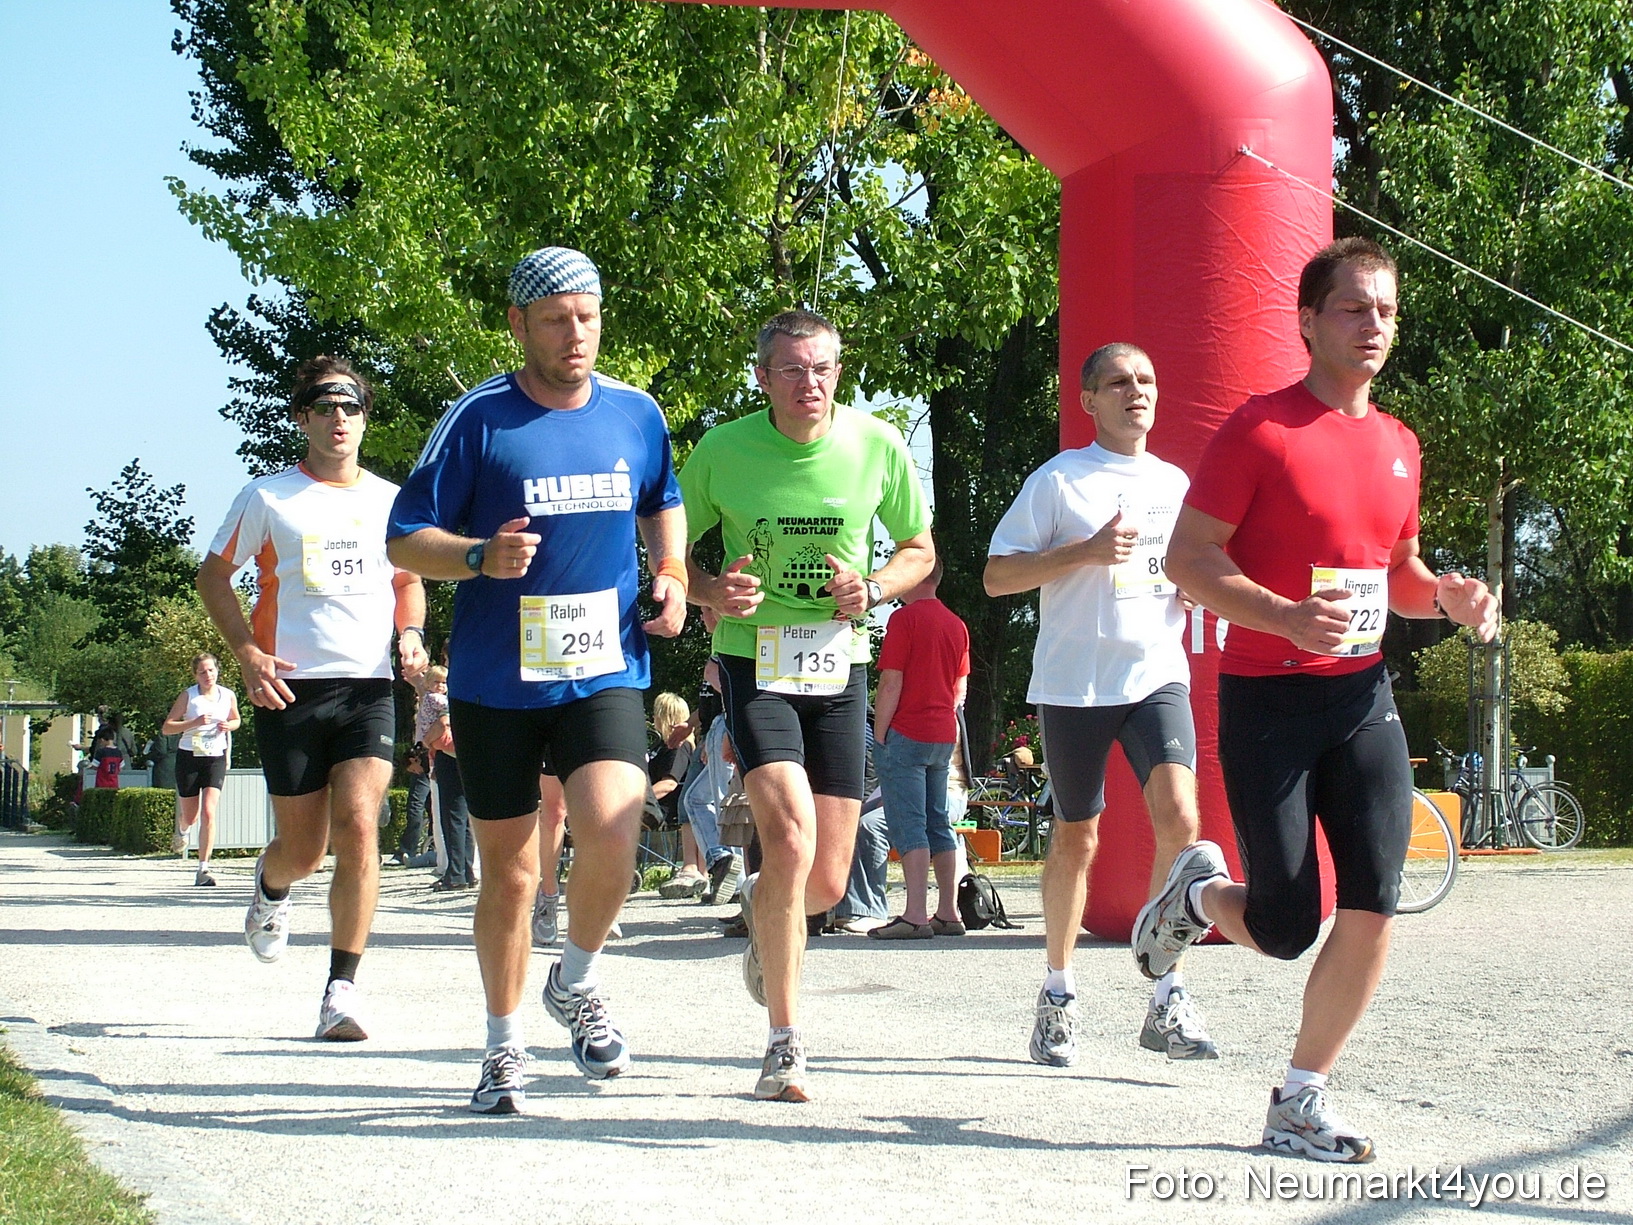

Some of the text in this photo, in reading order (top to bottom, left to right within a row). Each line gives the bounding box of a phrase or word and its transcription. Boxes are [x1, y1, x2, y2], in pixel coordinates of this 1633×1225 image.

[523, 472, 632, 504] HUBER
[777, 517, 845, 526] NEUMARKTER
[783, 527, 839, 535] STADTLAUF
[324, 539, 358, 550] Jochen
[331, 558, 363, 576] 951
[550, 602, 586, 622] Ralph
[526, 629, 533, 641] B
[783, 625, 817, 639] Peter
[561, 629, 605, 656] 294
[761, 645, 767, 657] C
[793, 651, 836, 673] 135
